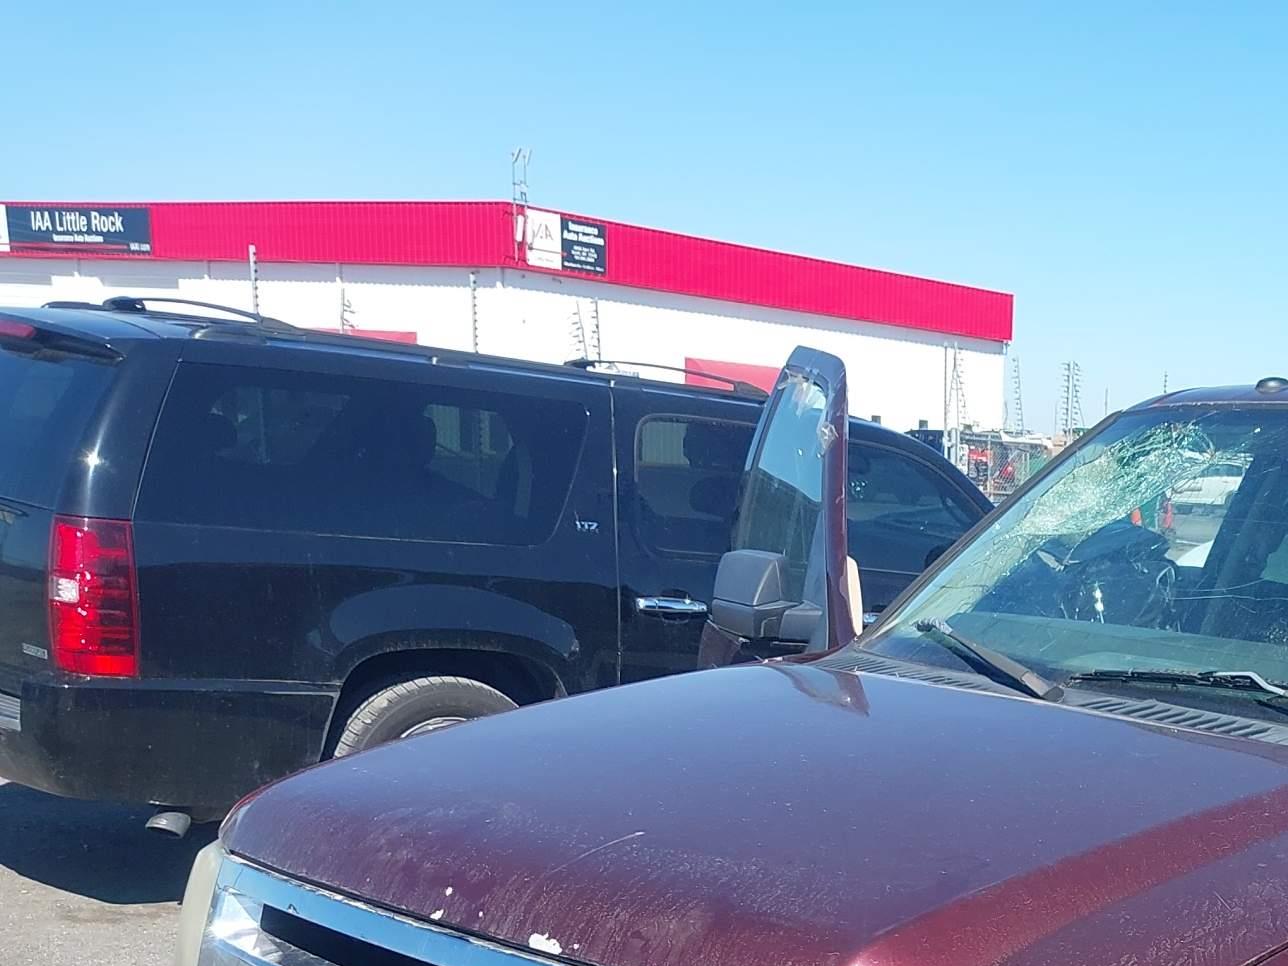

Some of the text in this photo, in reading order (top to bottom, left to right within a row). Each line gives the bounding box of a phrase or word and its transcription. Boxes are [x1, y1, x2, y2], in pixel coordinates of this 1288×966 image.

[30, 211, 124, 232] IAA Little Rock
